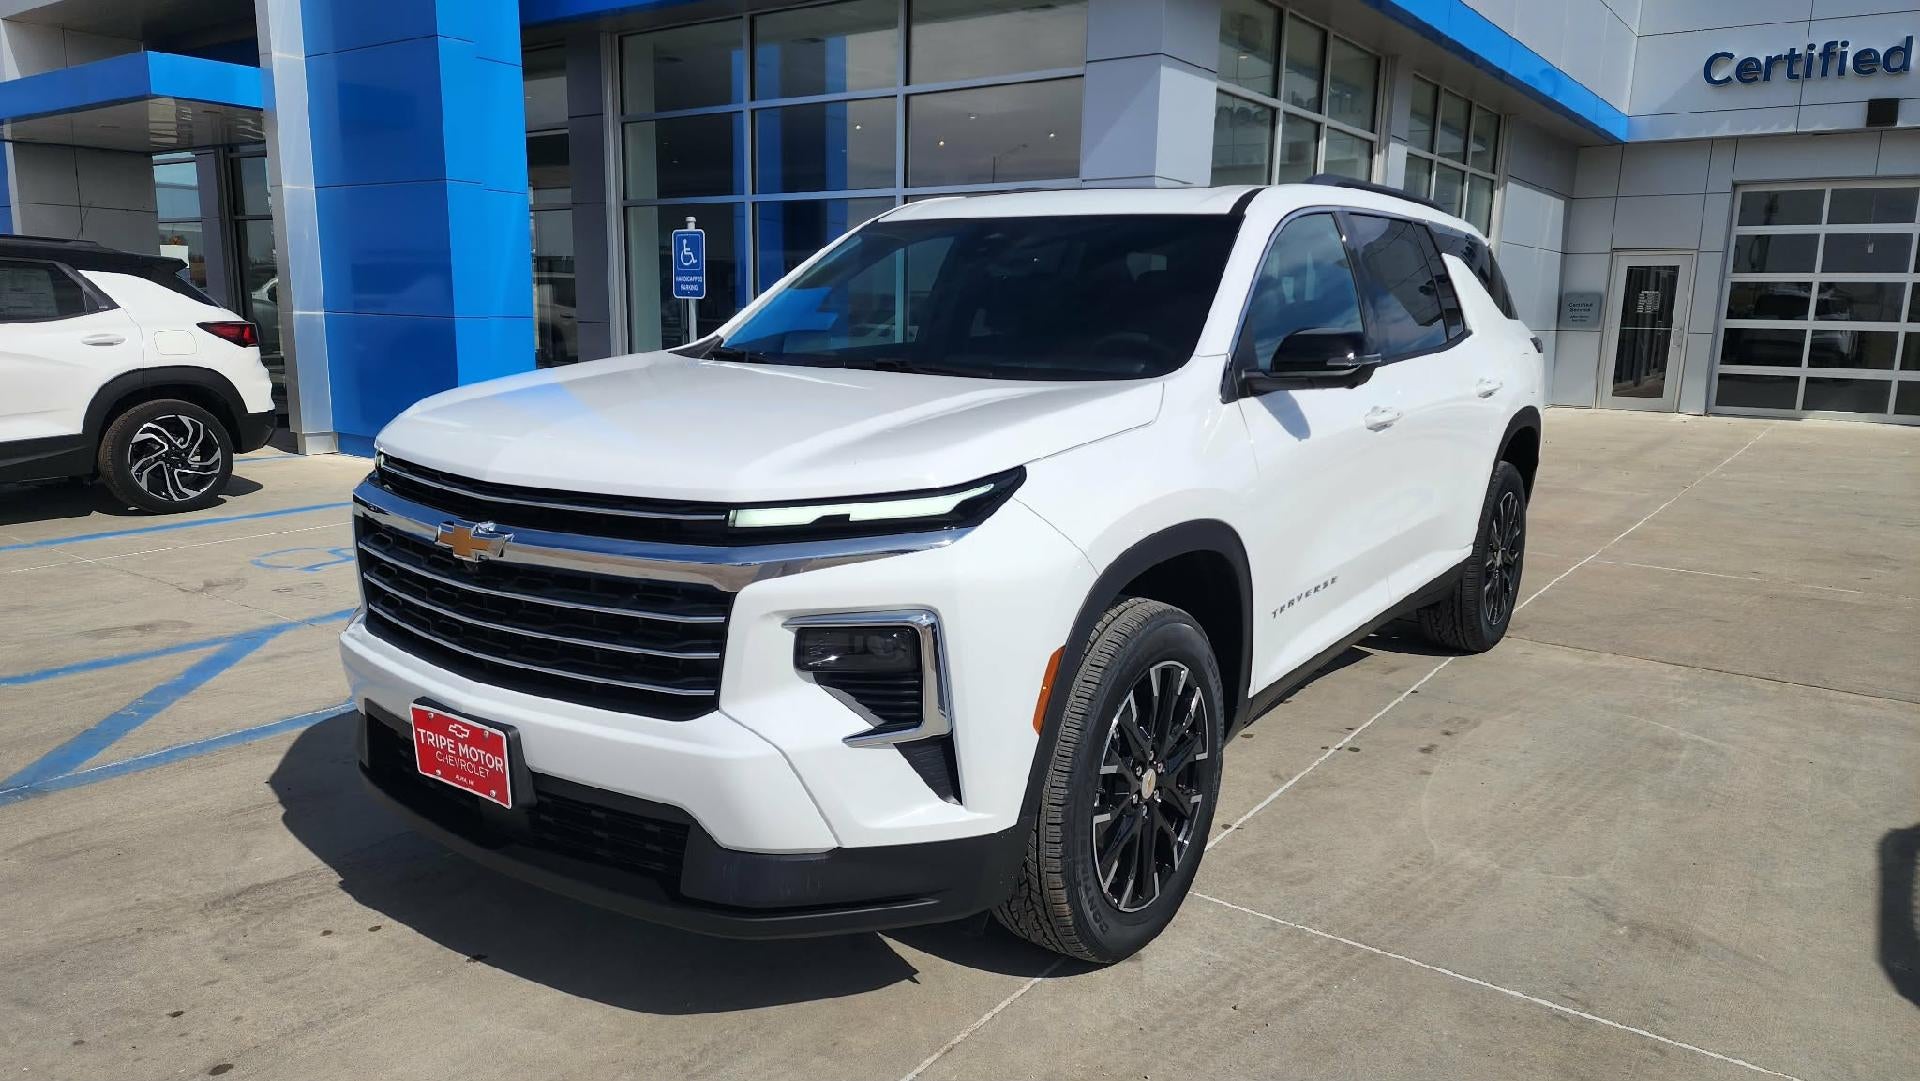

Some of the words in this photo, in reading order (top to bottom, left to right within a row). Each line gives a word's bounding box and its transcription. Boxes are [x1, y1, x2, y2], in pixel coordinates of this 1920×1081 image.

[1703, 35, 1914, 85] Certified
[1272, 576, 1338, 619] TRAVERSE
[417, 728, 456, 754] TRIPE
[458, 743, 504, 774] MOTOR
[436, 751, 489, 778] CHEVROLET
